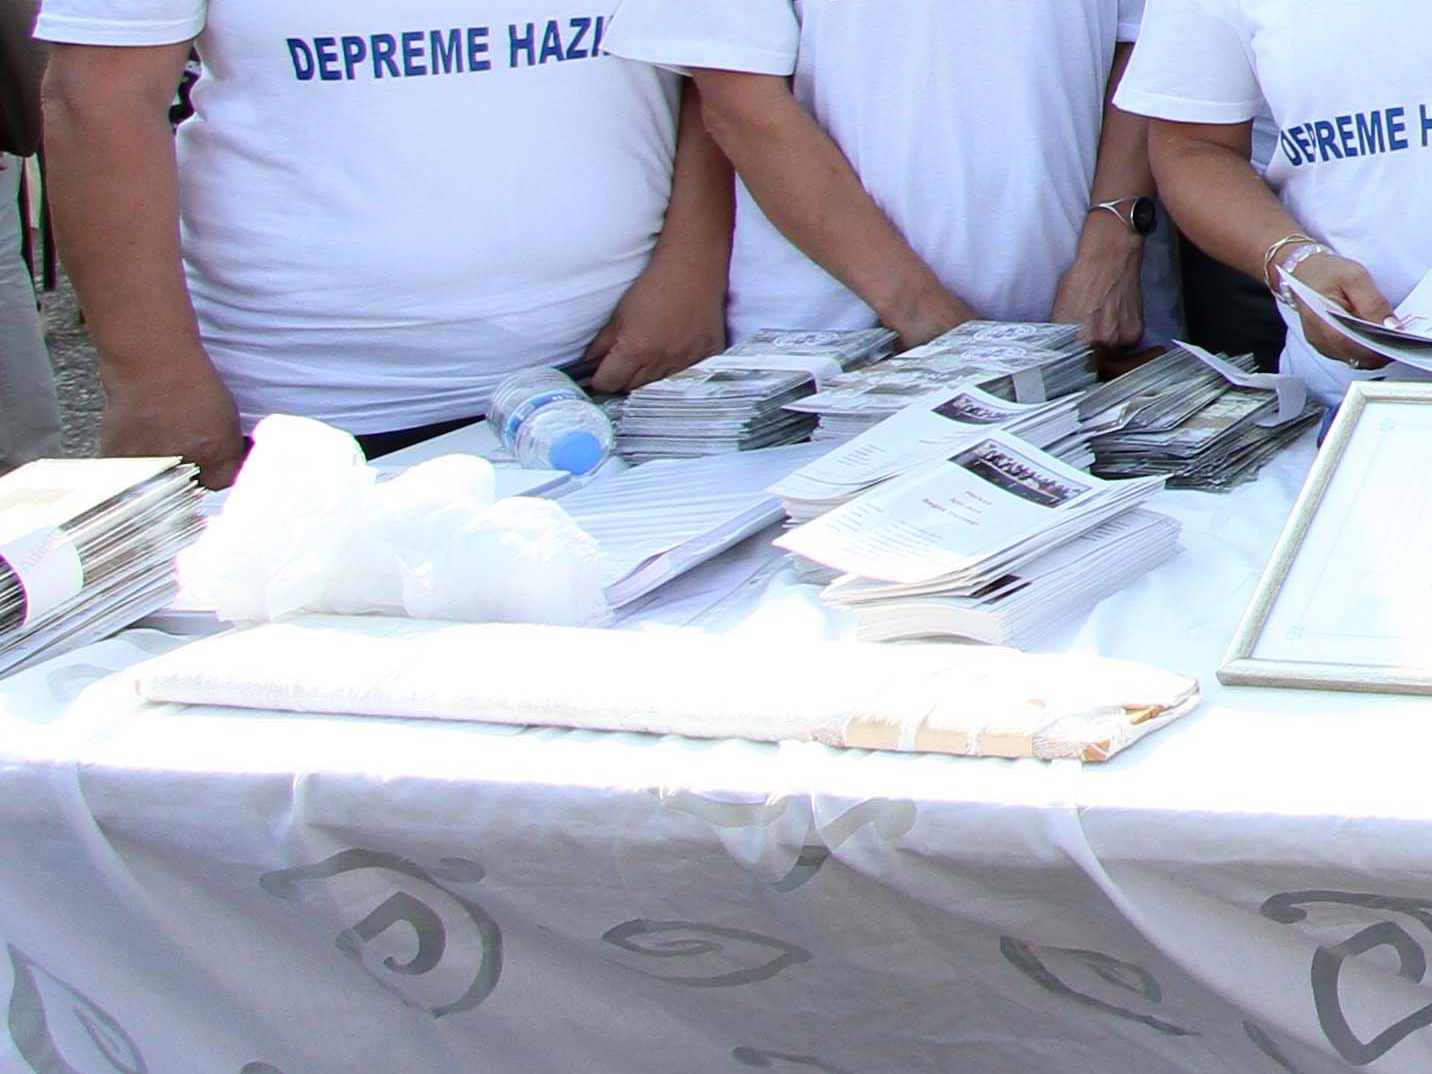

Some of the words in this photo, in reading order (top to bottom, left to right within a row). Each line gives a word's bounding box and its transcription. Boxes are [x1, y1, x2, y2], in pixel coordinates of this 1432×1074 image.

[286, 25, 492, 82] DEPREME
[508, 15, 611, 69] HAZI
[1280, 106, 1408, 167] DEPREME
